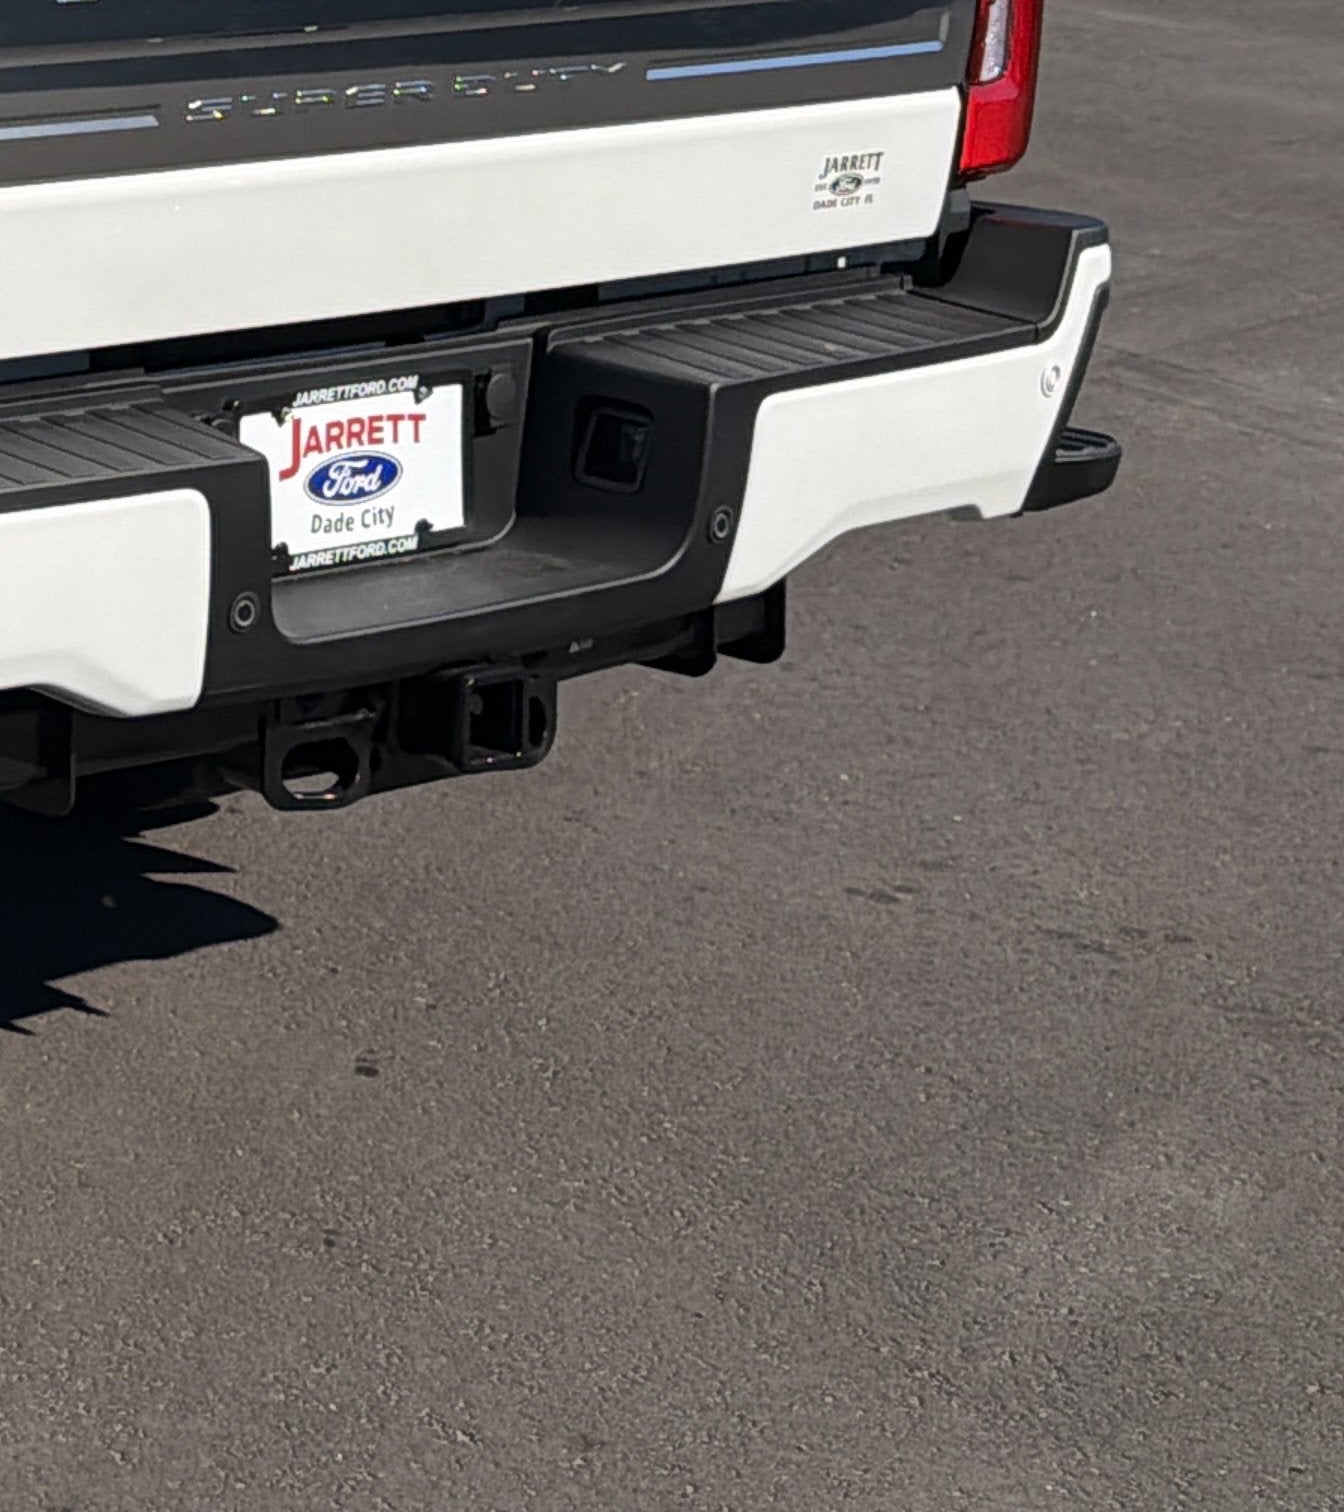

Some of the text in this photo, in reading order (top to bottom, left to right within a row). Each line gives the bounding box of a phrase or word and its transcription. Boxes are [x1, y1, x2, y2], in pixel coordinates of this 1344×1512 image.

[818, 151, 885, 180] JARRETT
[292, 374, 420, 408] JARRETTFORD.COM
[321, 458, 384, 498] Ford
[310, 505, 395, 534] Dade City
[288, 535, 420, 572] JARRETTFORD.COM
